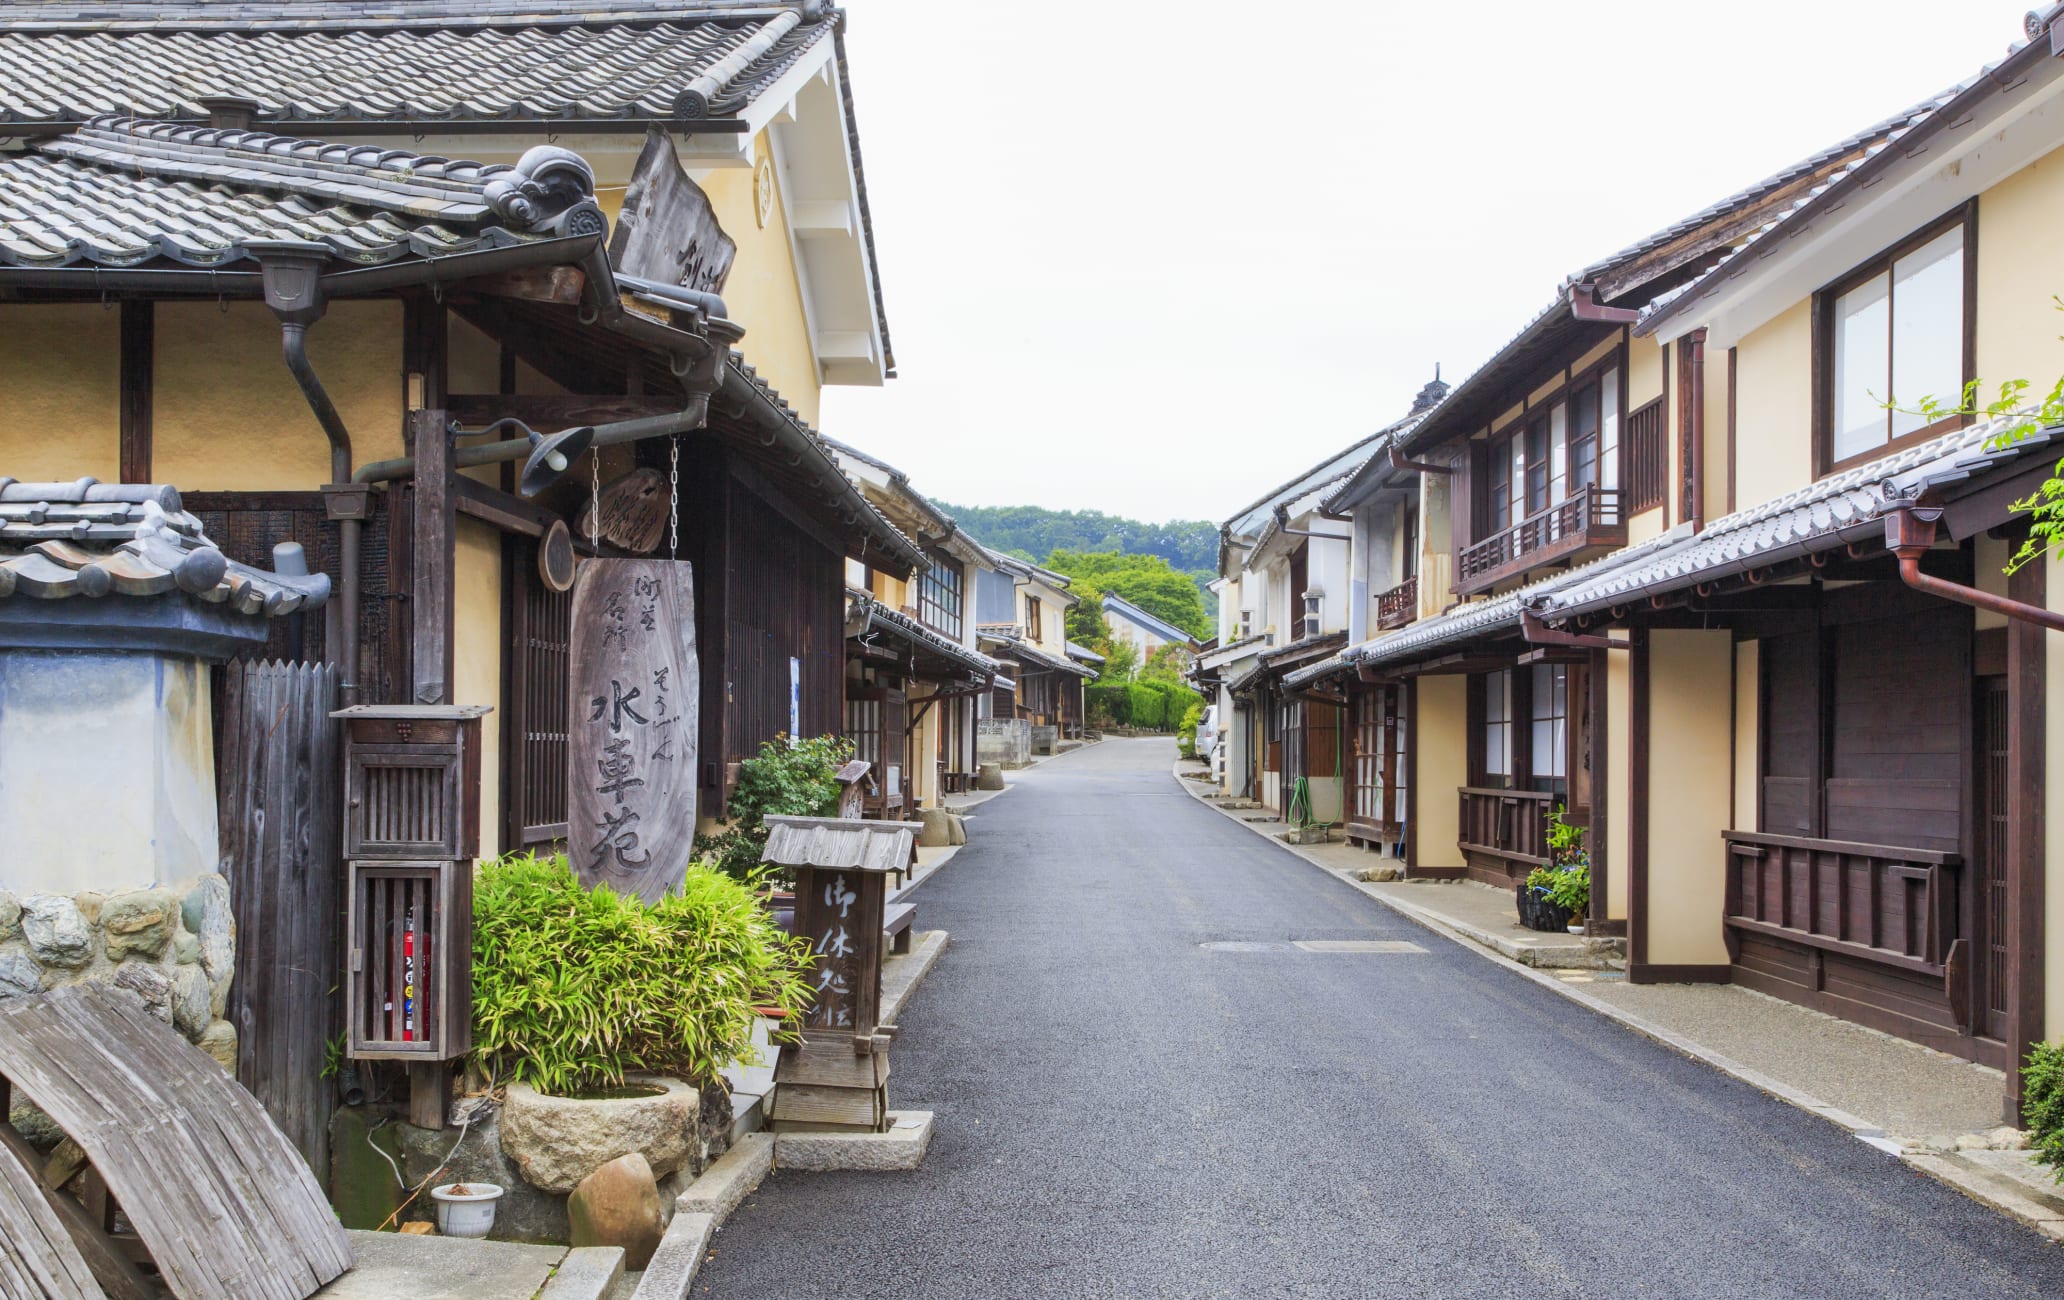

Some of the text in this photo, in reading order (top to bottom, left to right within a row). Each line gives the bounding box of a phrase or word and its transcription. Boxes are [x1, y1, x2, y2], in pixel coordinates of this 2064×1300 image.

[651, 666, 680, 762] そうげん
[588, 679, 652, 872] 水車苑
[816, 873, 857, 995] 御休処
